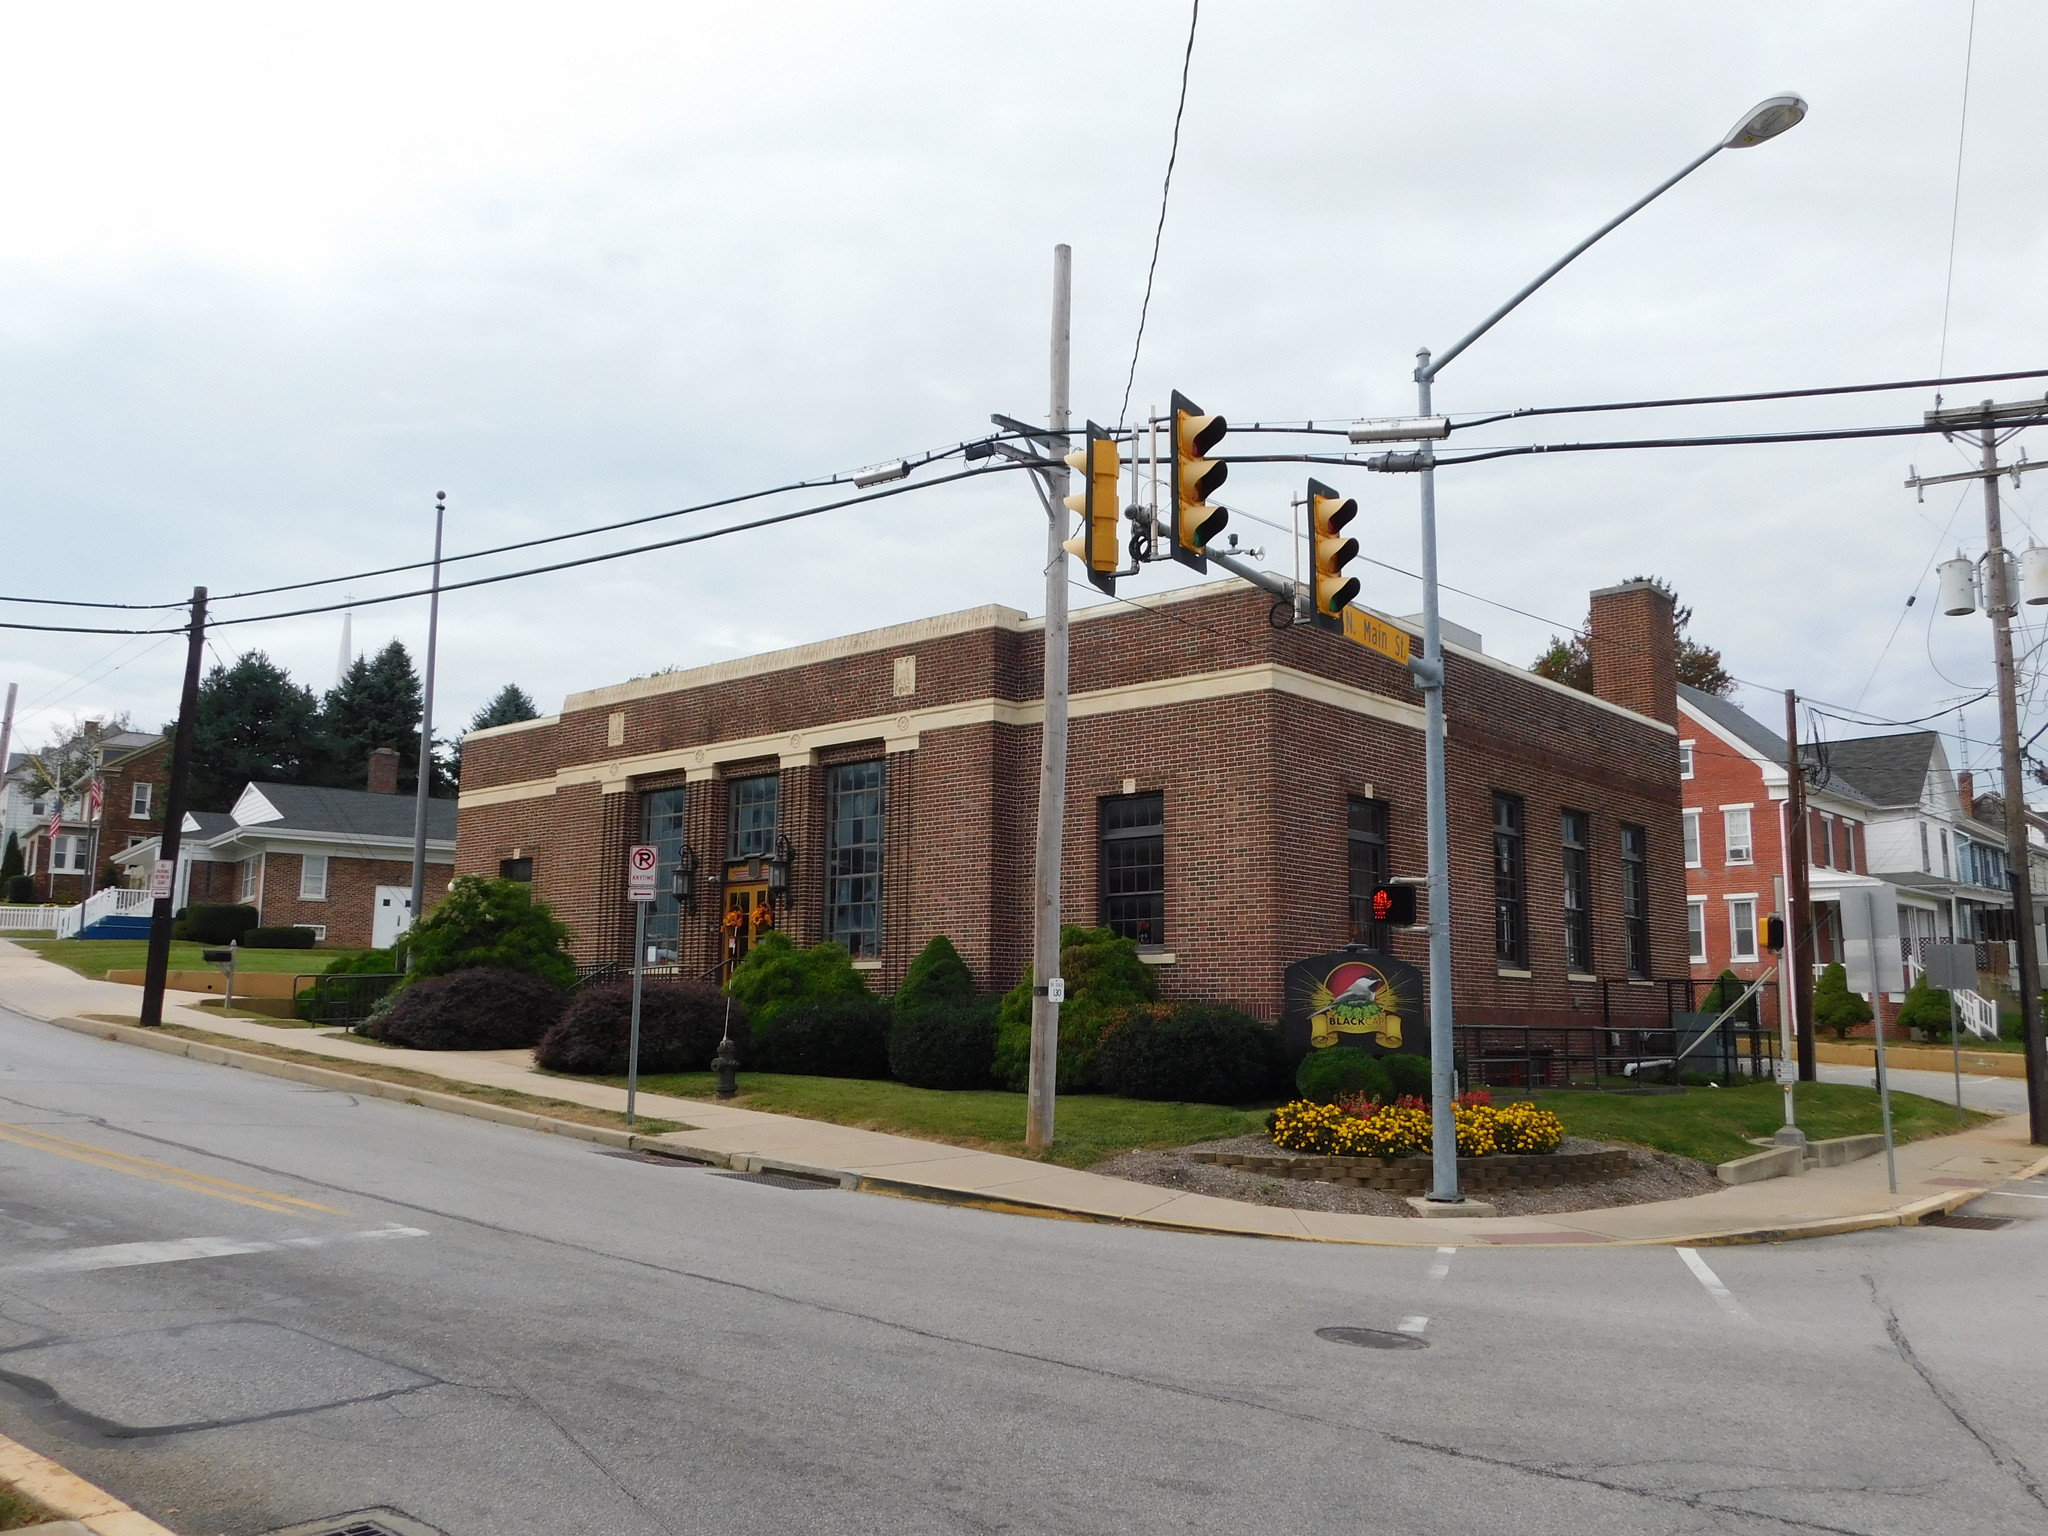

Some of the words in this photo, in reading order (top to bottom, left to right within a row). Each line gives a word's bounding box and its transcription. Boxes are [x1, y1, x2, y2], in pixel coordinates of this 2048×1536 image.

[1345, 610, 1356, 635] N.
[1363, 619, 1387, 650] Main
[1395, 634, 1407, 660] St.
